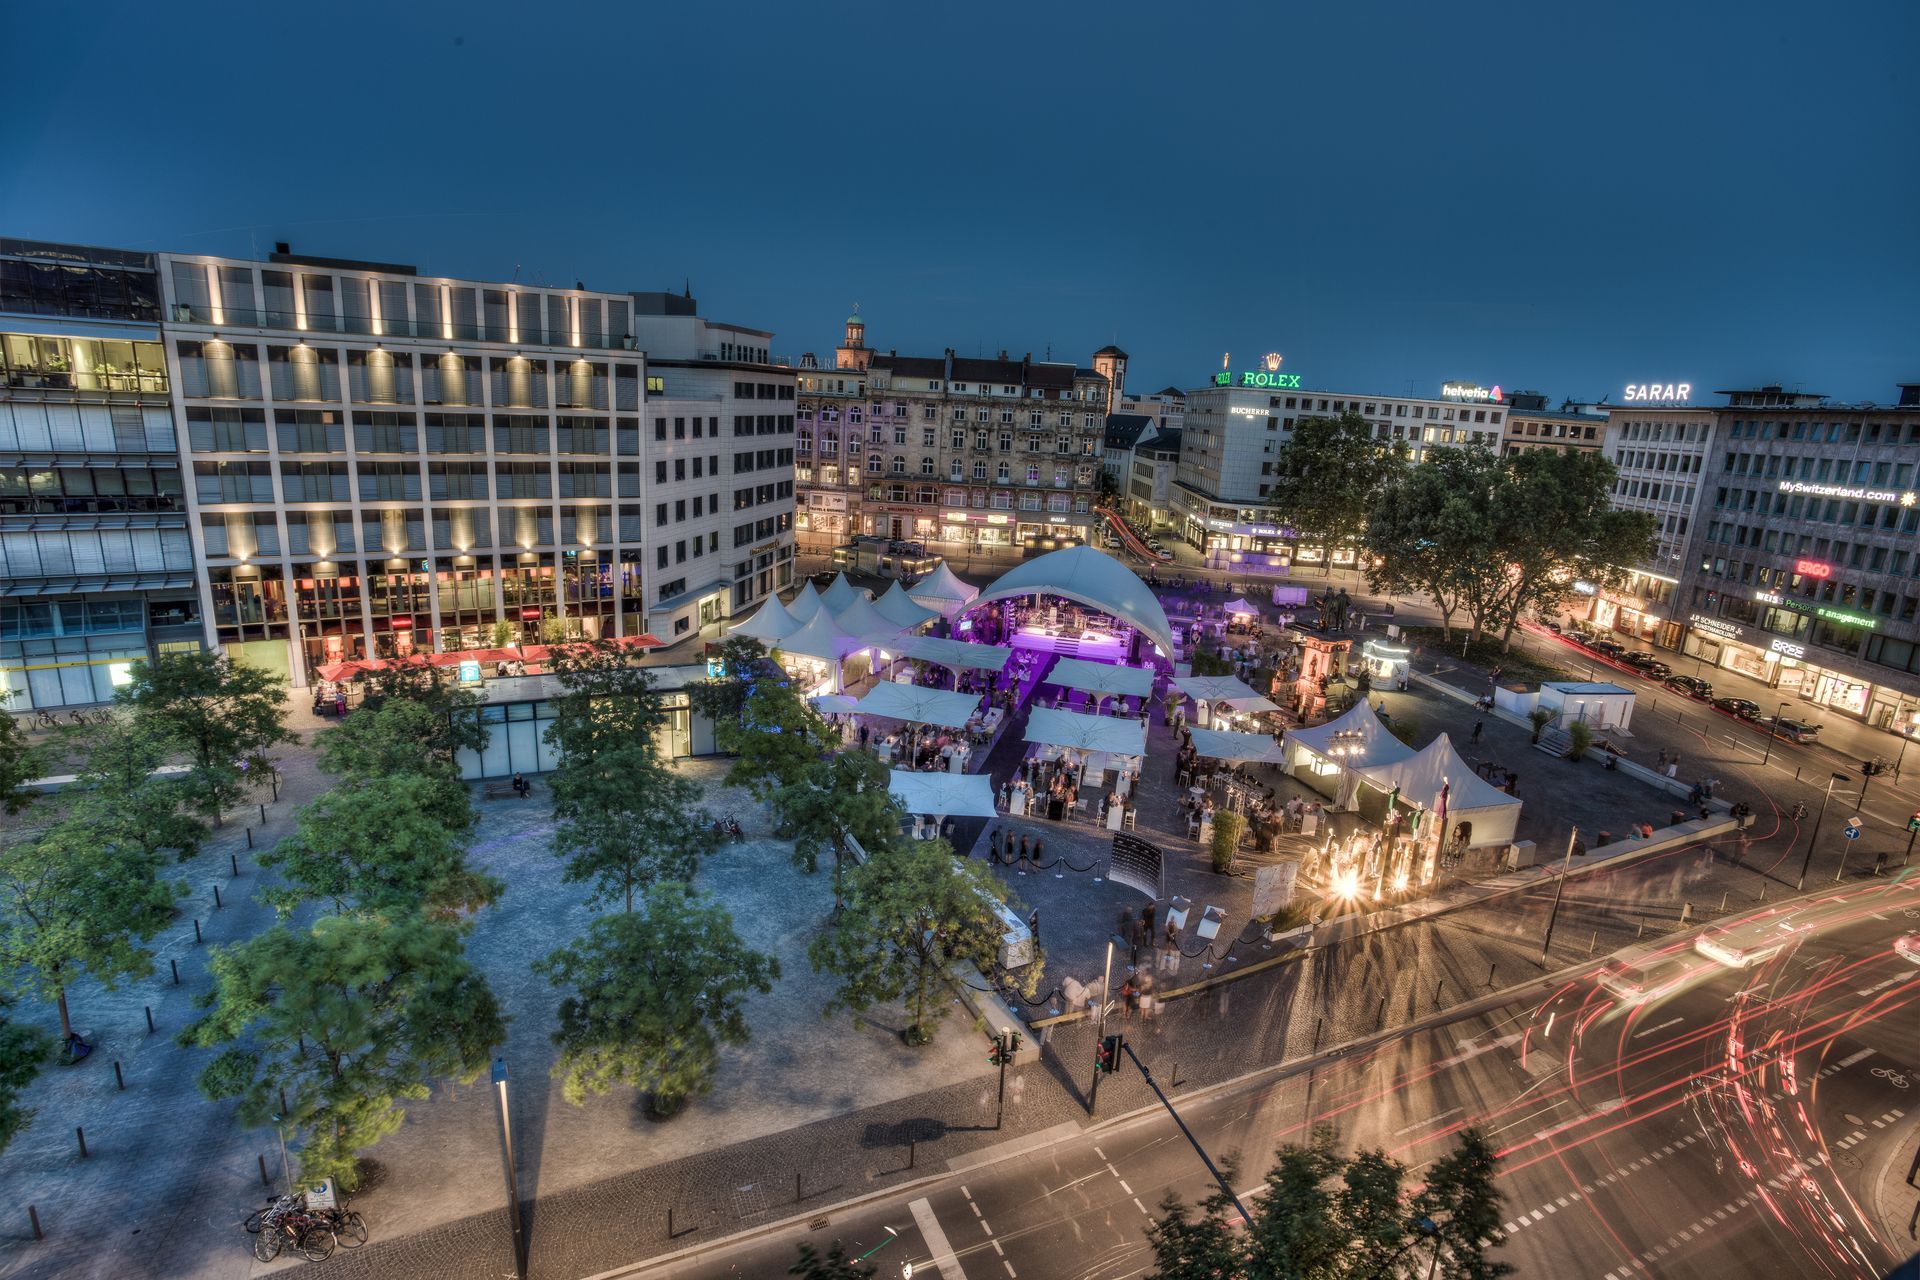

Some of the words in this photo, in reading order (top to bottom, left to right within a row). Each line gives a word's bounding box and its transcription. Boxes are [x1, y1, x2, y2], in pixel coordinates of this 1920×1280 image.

[1244, 372, 1300, 387] ROLEX
[1443, 384, 1488, 398] helvetia
[1624, 384, 1690, 400] SARAR
[1231, 406, 1269, 415] BUCHERER
[1780, 481, 1896, 501] MySwitzerland.com
[1797, 560, 1830, 577] ERGO
[1756, 591, 1784, 605] WEISS
[1694, 622, 1736, 640] KUNSTHANDLUNG
[1700, 616, 1735, 632] SCHNEIDER
[1771, 639, 1804, 658] BREE
